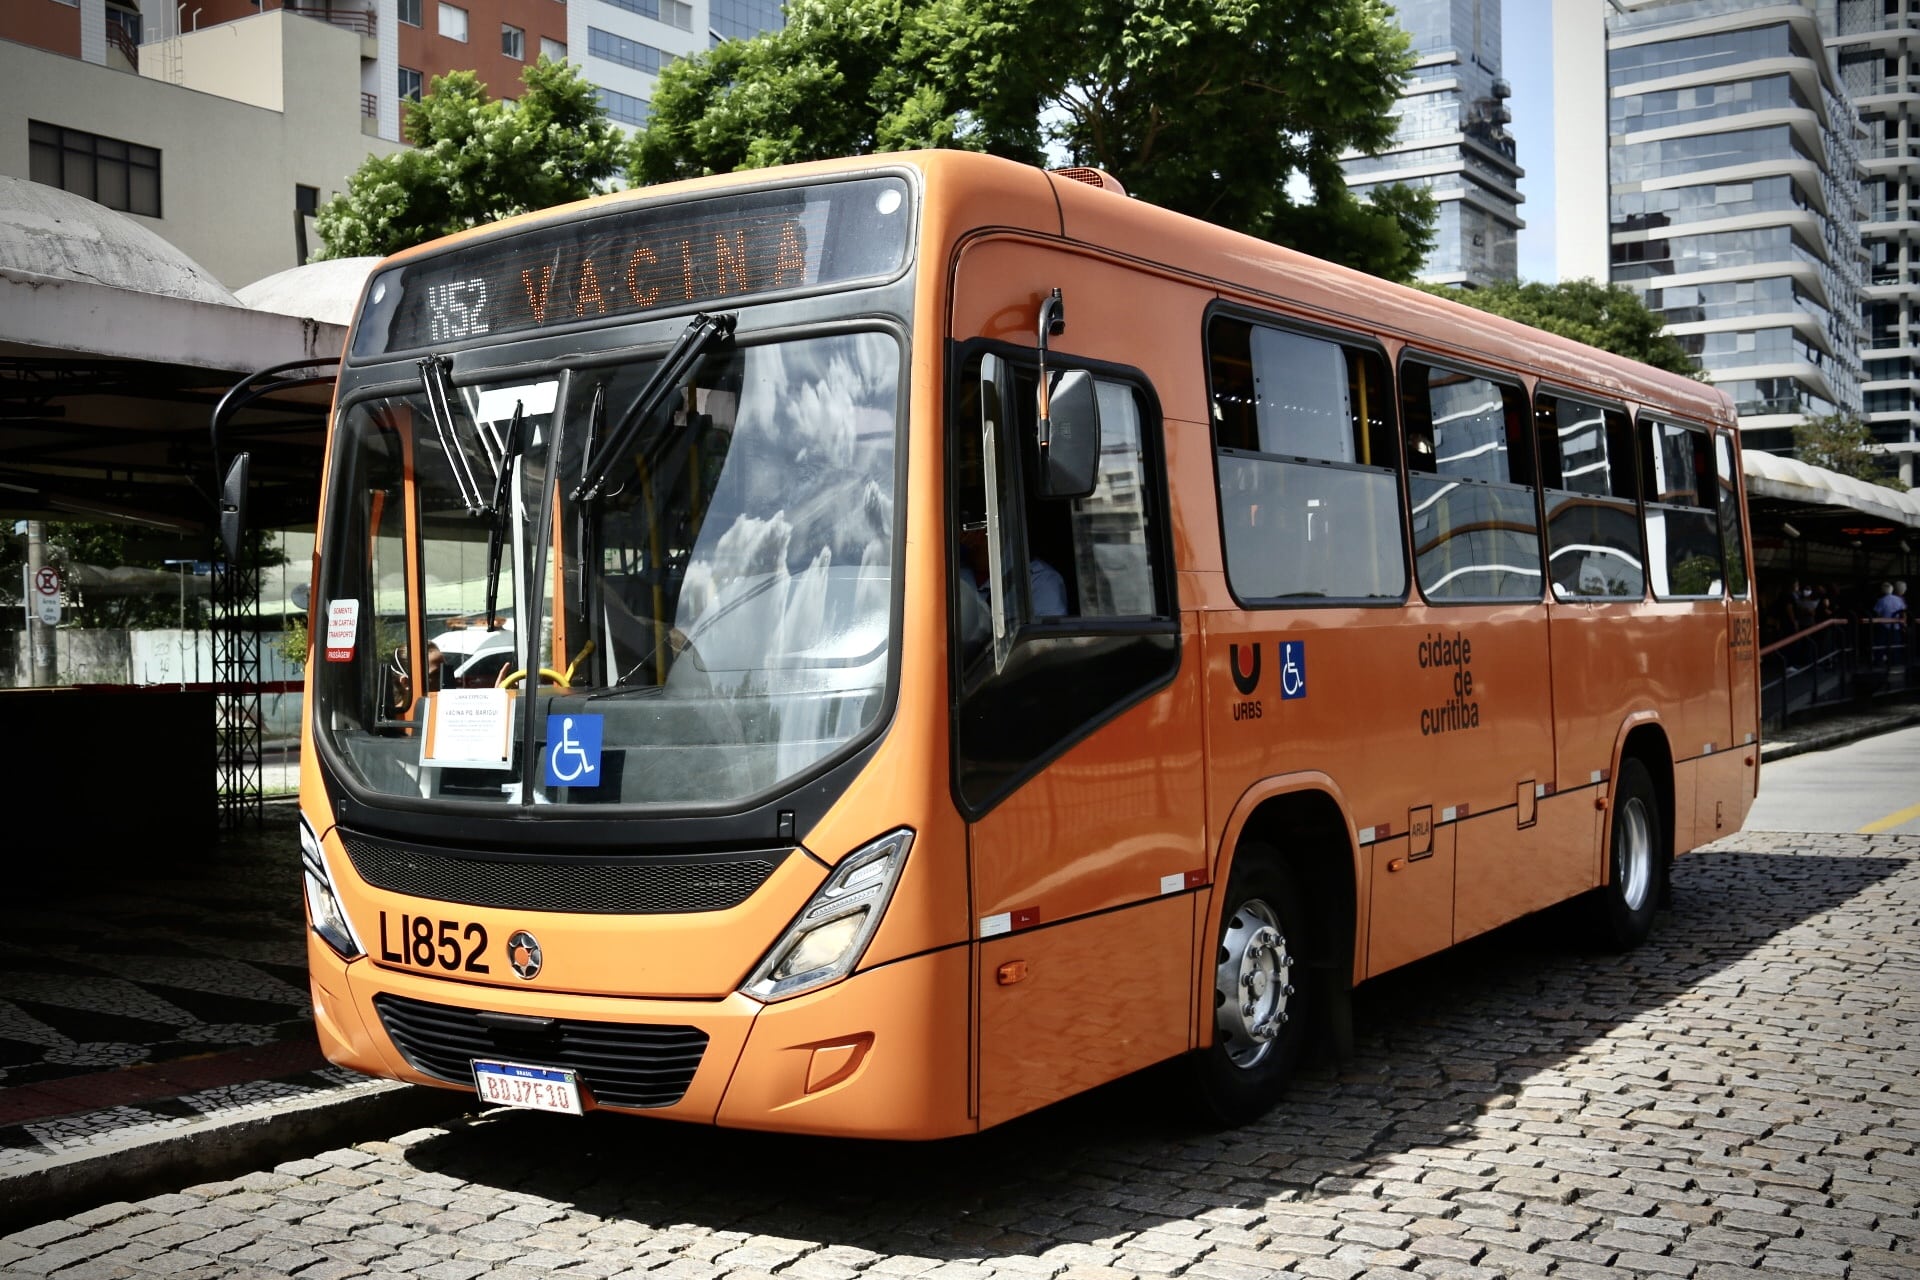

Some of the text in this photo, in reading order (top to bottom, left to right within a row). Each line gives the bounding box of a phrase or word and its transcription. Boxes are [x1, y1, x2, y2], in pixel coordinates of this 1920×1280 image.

[521, 221, 808, 325] VACINA
[1418, 631, 1471, 668] cidade
[1453, 662, 1472, 699] de
[1233, 701, 1262, 721] URBS
[1420, 699, 1479, 736] curitiba
[1412, 821, 1429, 837] ARLA
